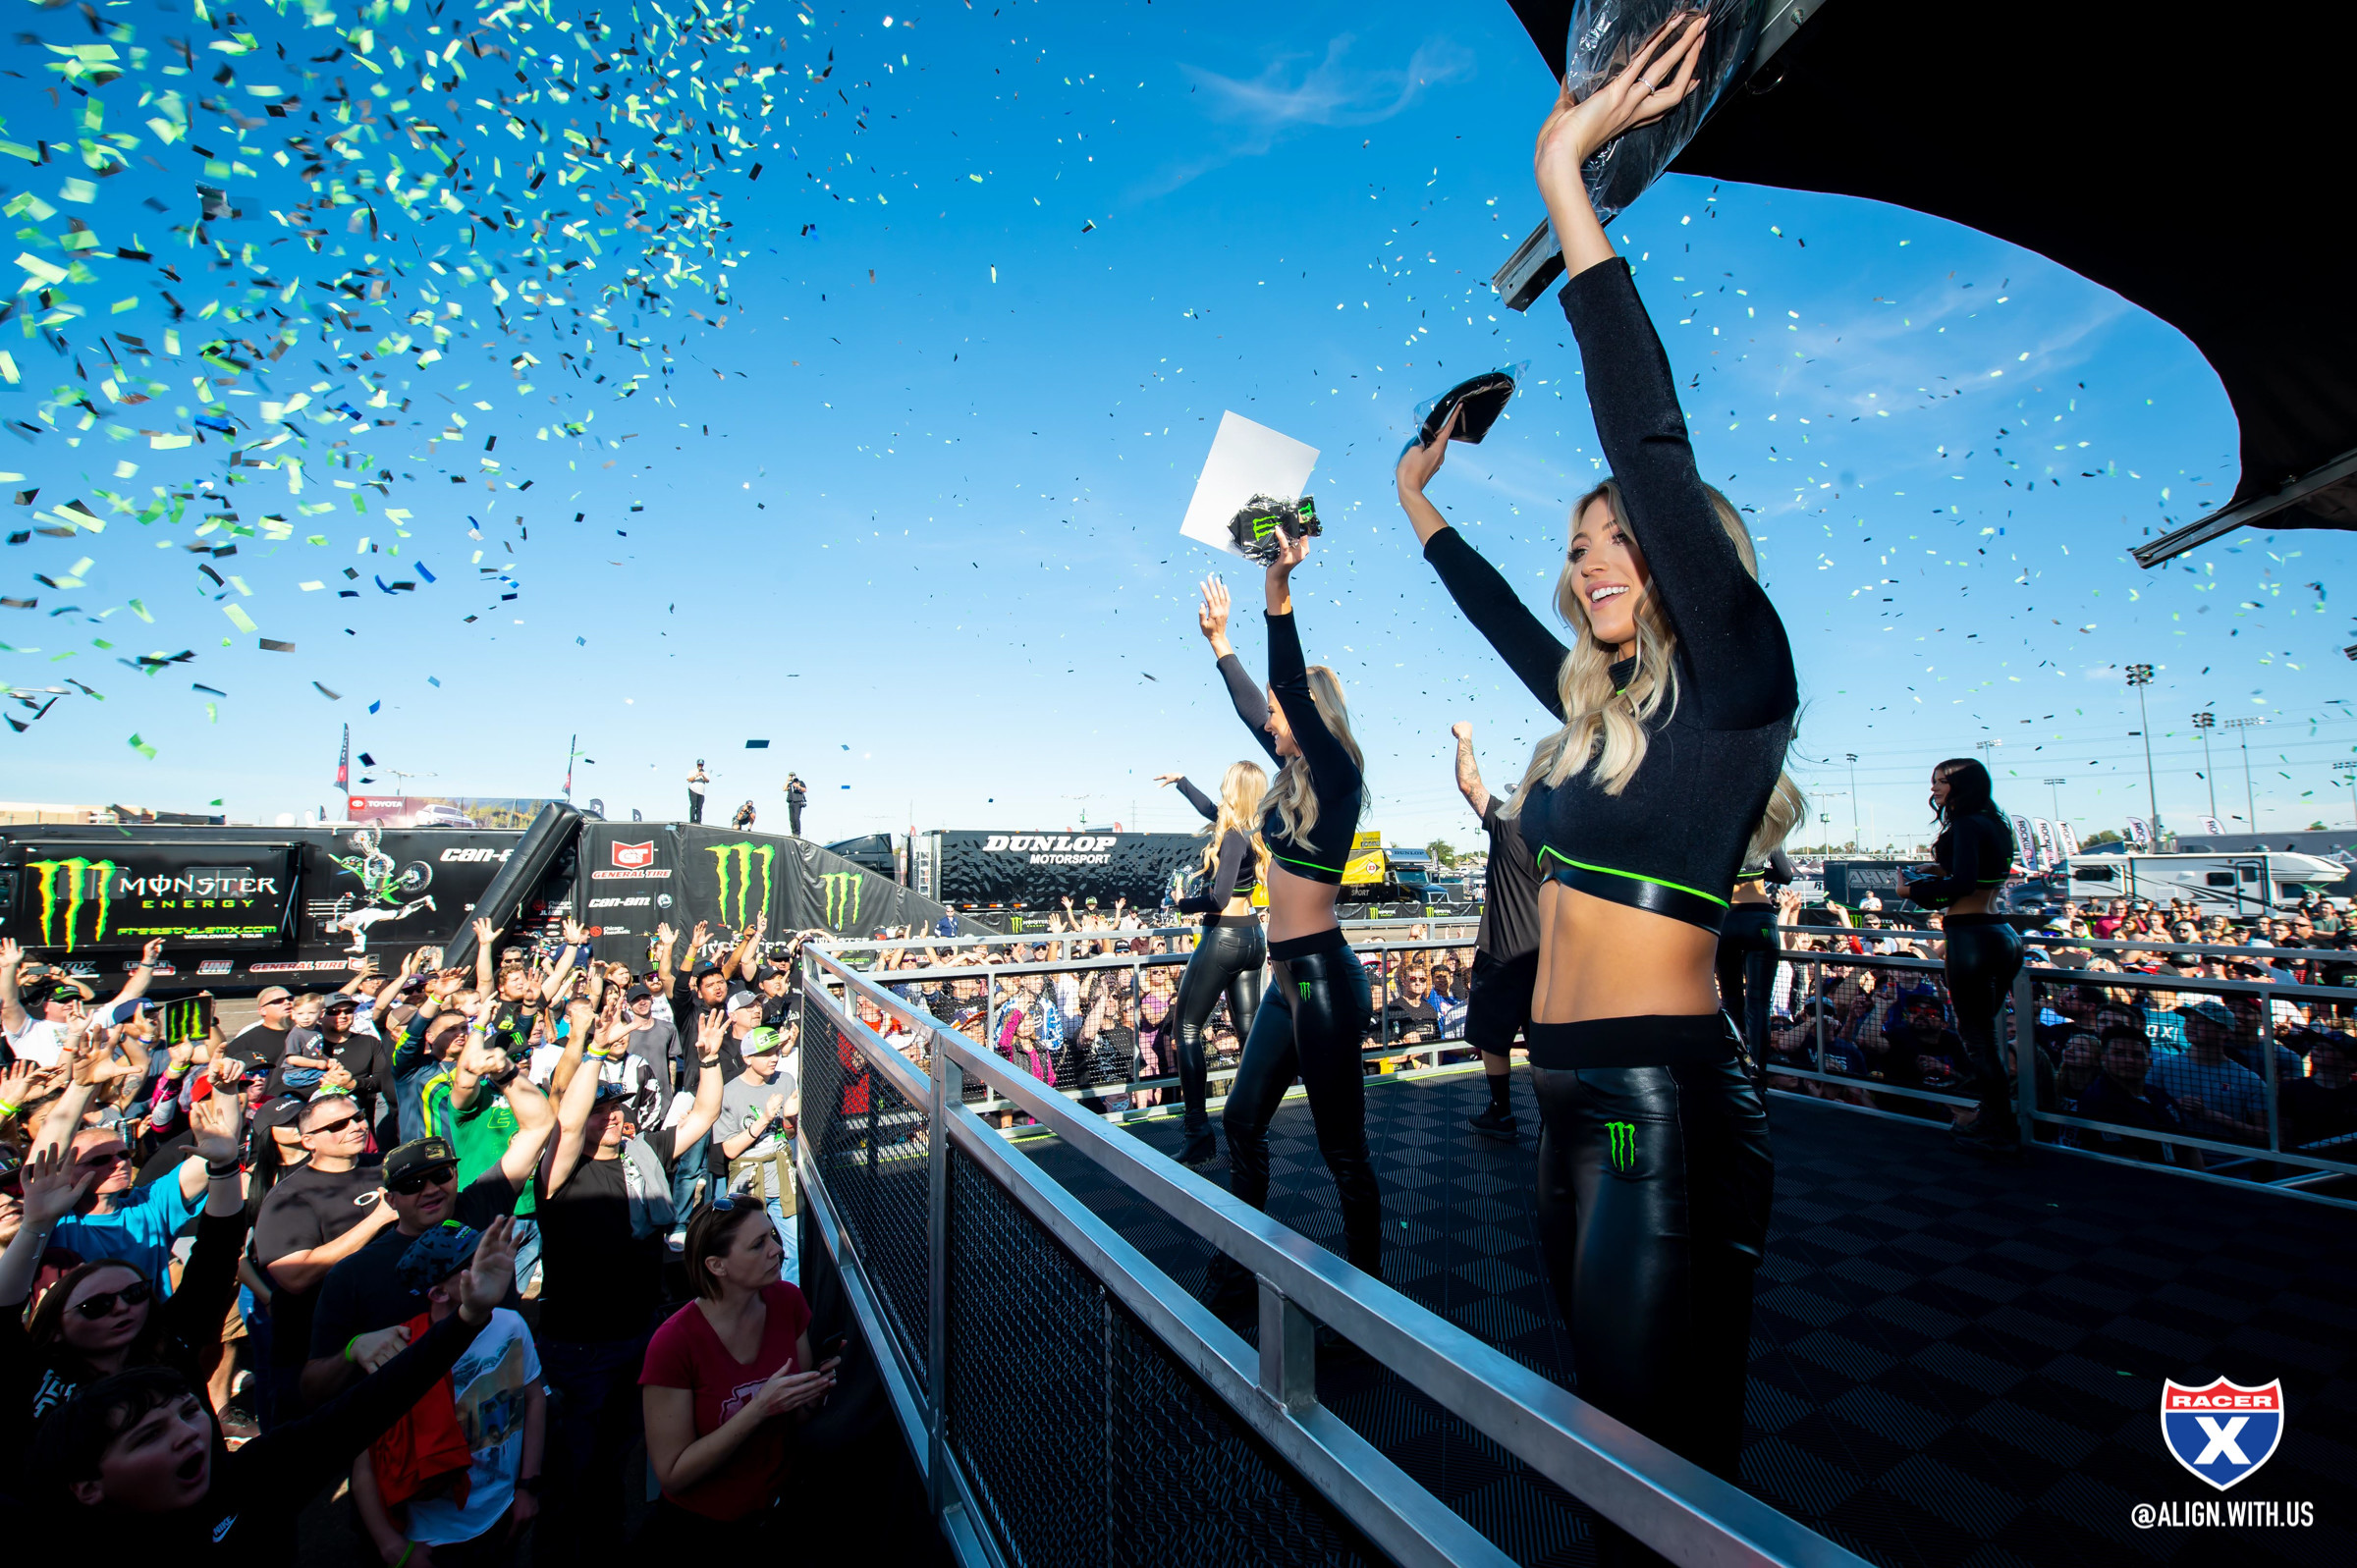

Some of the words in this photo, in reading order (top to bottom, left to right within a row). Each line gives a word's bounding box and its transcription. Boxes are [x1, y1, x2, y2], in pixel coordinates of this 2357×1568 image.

[982, 836, 1117, 852] DUNLOP
[618, 848, 648, 863] GT
[1029, 854, 1111, 864] MOTORSPORT
[119, 874, 279, 896] MONSTER
[141, 899, 254, 909] ENERGY
[588, 897, 651, 907] can-am
[251, 961, 313, 971] GENERAL
[316, 961, 347, 970] TIRE
[212, 1515, 232, 1537] NIKE
